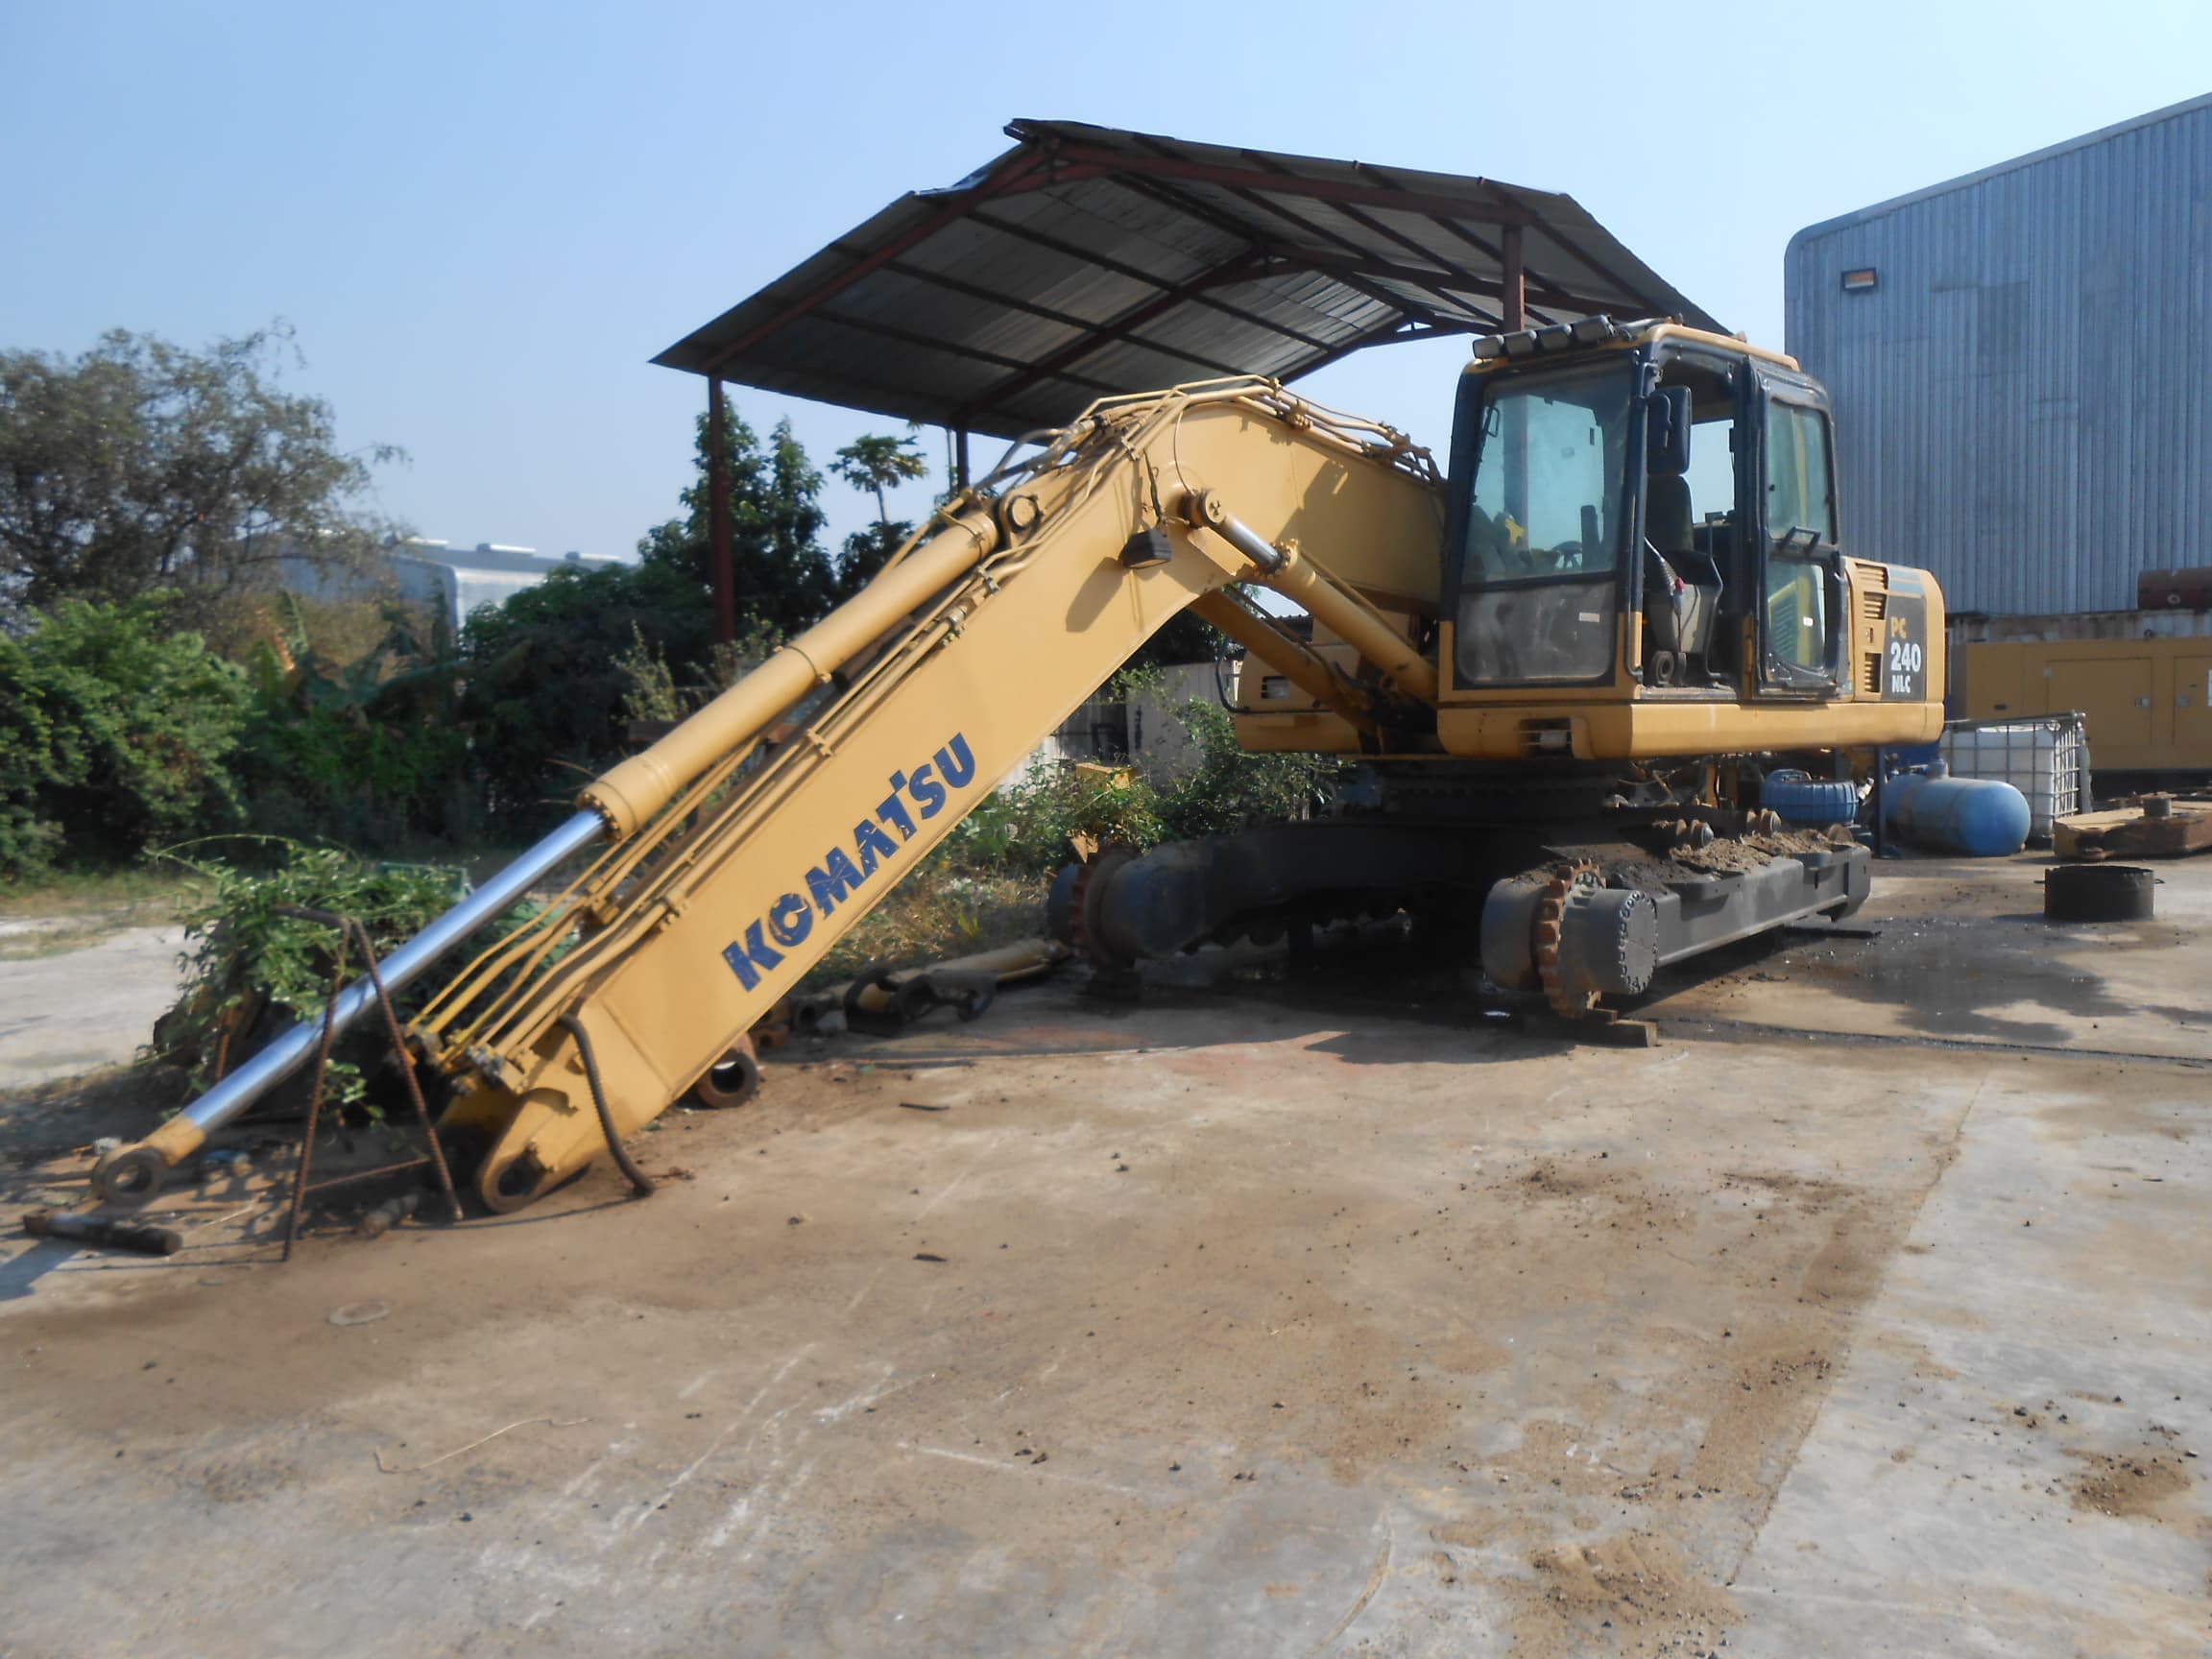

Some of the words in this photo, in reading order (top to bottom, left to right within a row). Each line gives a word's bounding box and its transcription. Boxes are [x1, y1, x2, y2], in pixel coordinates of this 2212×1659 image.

[1890, 616, 1907, 639] PC
[1890, 641, 1921, 672] 240
[1891, 675, 1911, 693] NLC
[721, 733, 975, 993] KOMATSU
